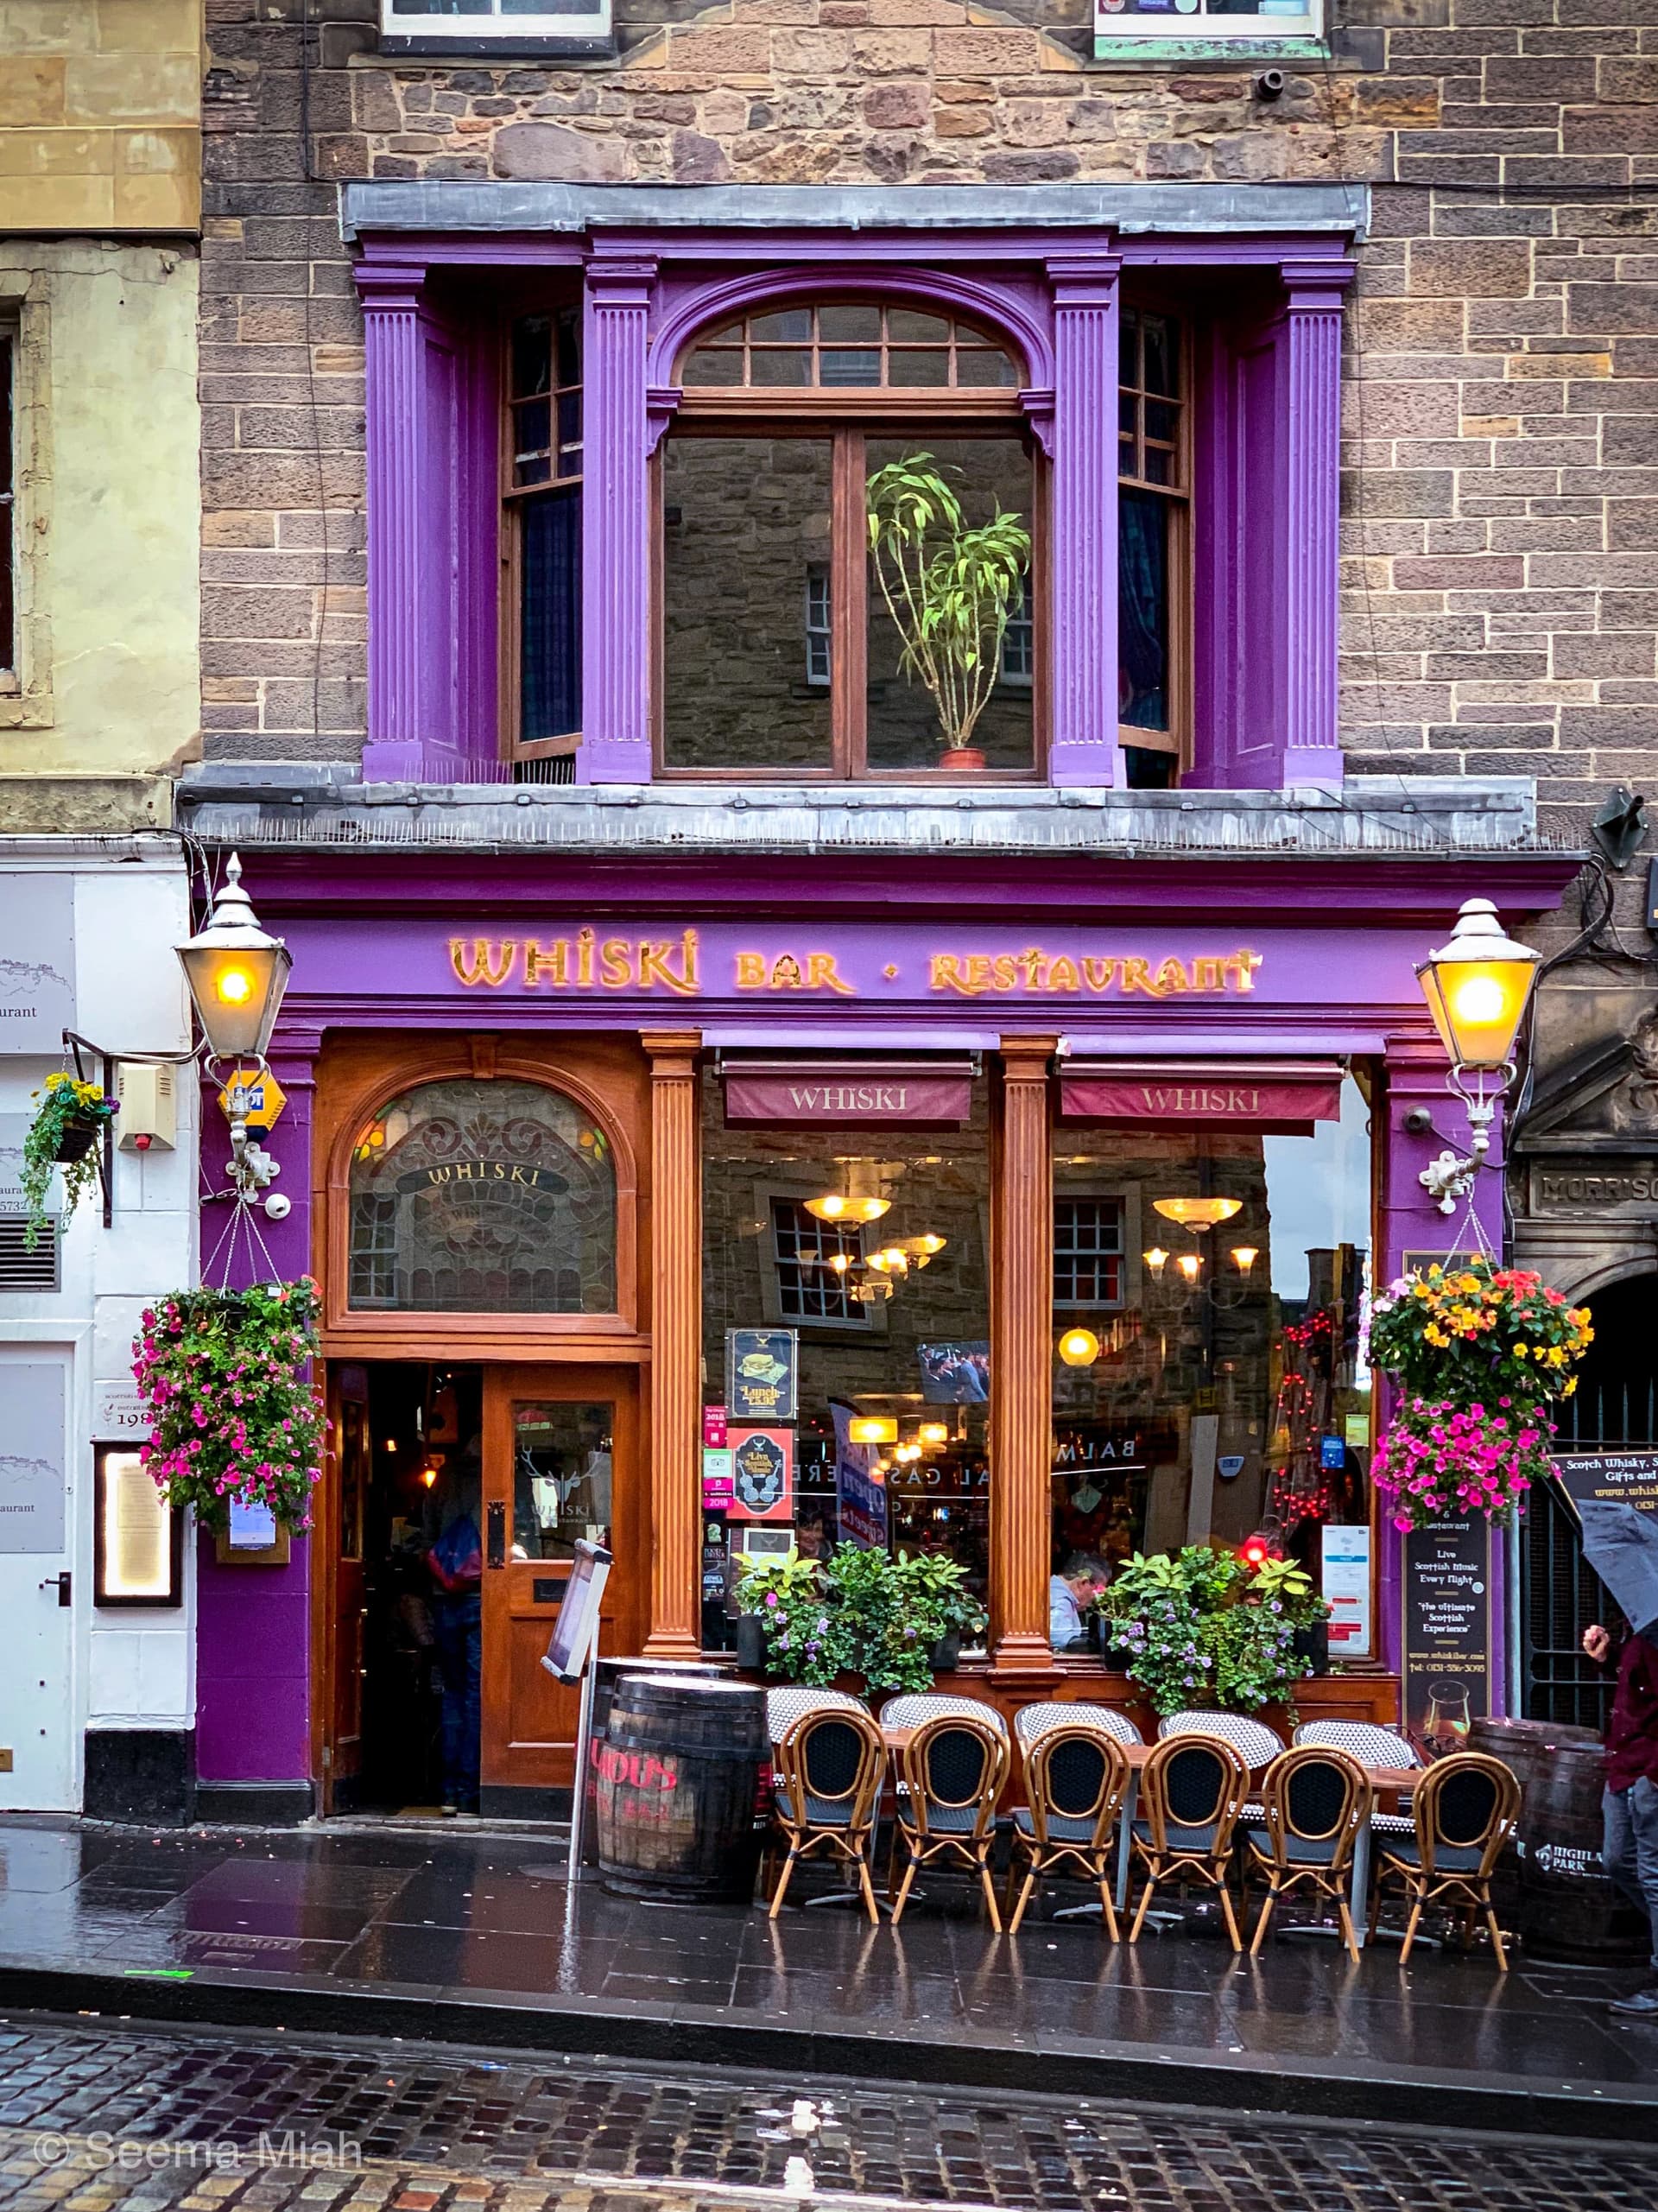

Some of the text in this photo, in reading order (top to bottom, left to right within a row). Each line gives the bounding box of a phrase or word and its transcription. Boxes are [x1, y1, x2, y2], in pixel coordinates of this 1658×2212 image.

[448, 927, 1263, 997] WHISKI BAR RESTAURANT
[788, 1087, 907, 1110] WHISKI
[1140, 1087, 1260, 1112] WHISKI
[428, 1162, 539, 1187] WHISKI
[117, 1412, 163, 1428] 198
[1566, 1459, 1602, 1471] Scotch
[1605, 1470, 1656, 1482] Gifts and
[1437, 1550, 1457, 1559] Live
[1414, 1562, 1451, 1572] Scottish
[1420, 1574, 1473, 1587] Every Night
[1428, 1613, 1465, 1623] Scottish
[1554, 1846, 1604, 1863] HIGHLA
[1553, 1857, 1586, 1872] PARK
